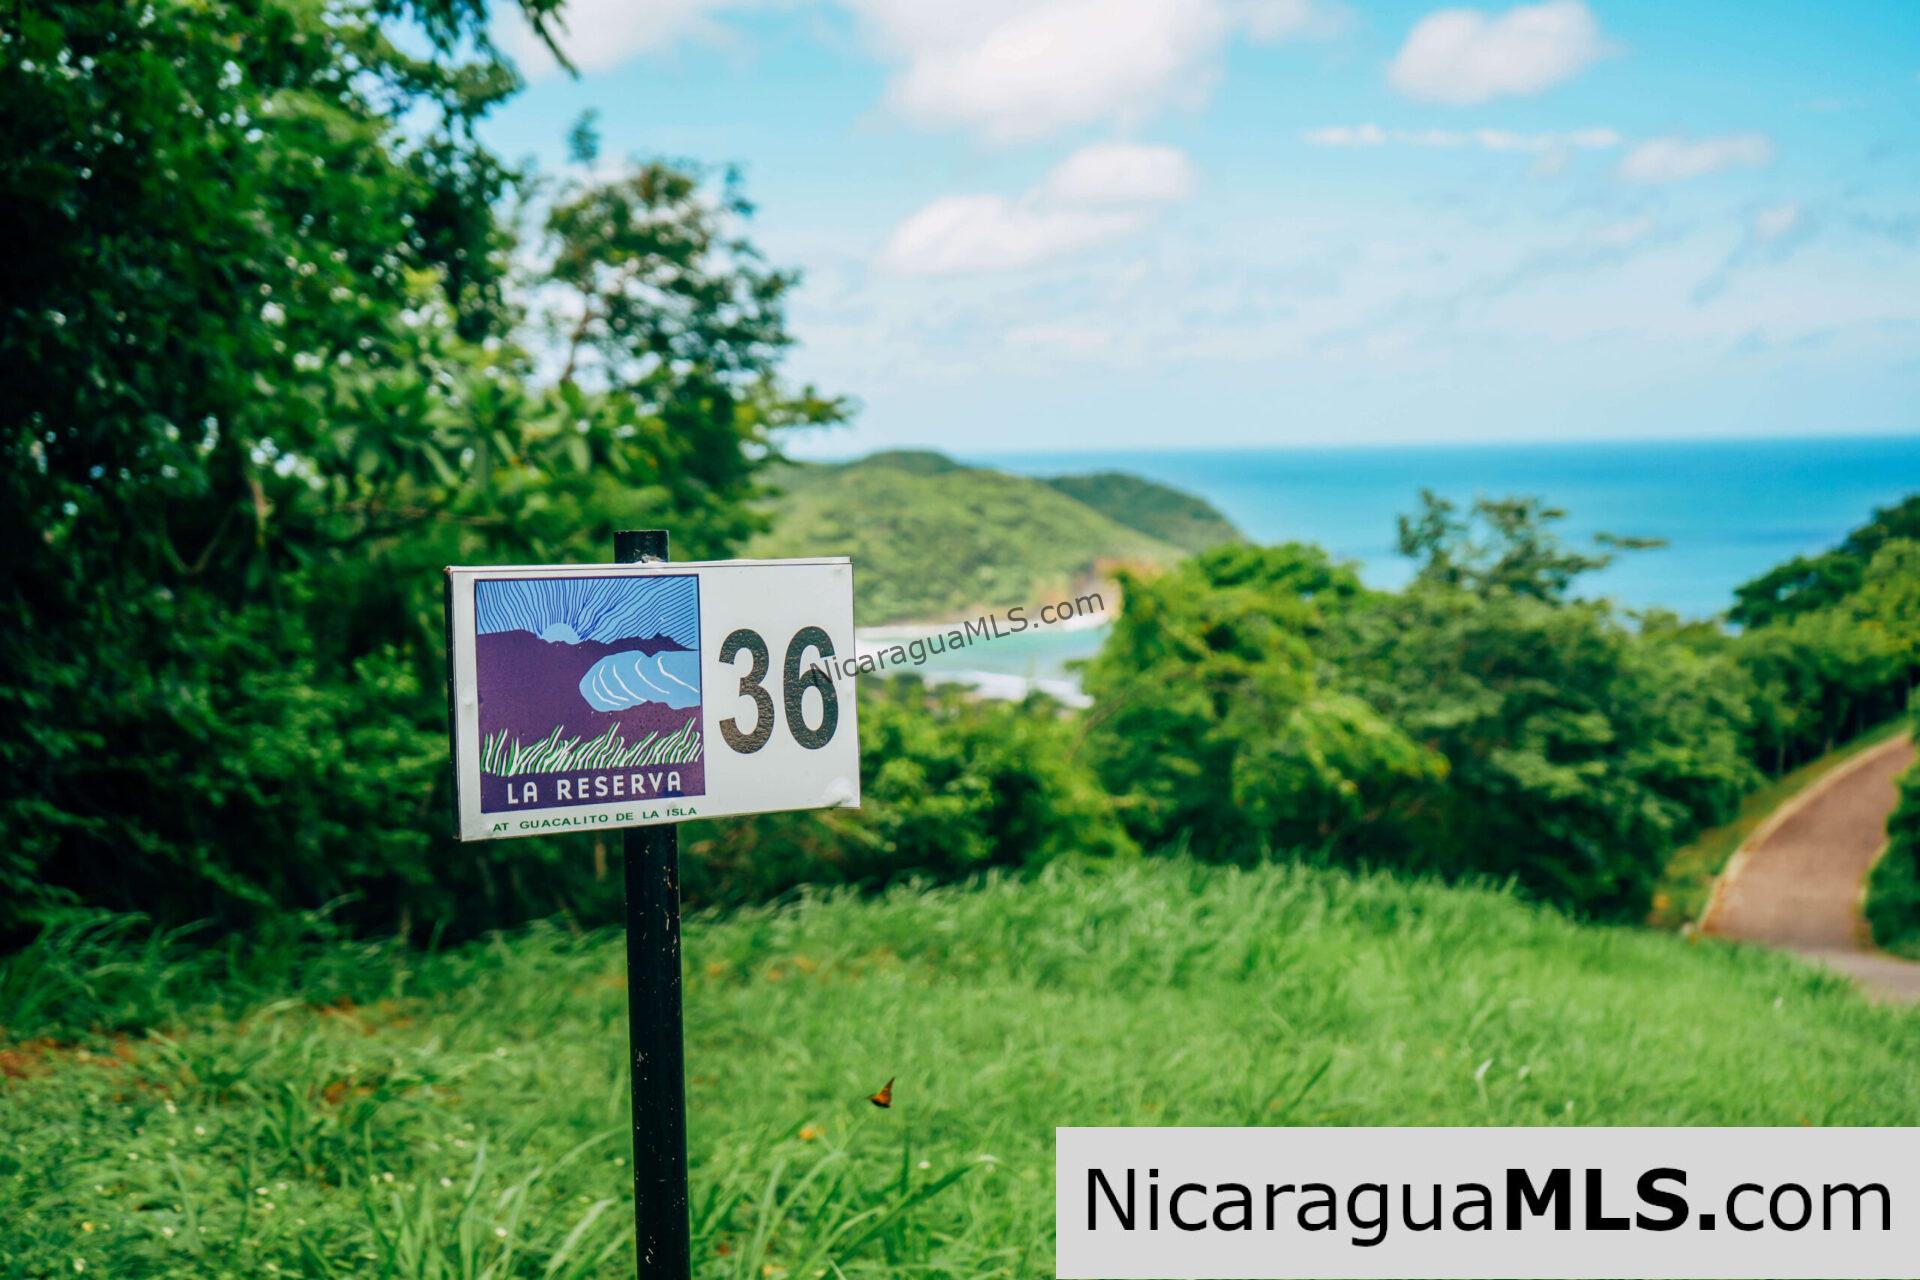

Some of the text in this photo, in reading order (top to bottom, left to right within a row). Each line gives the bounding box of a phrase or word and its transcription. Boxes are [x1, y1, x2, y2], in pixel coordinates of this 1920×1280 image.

[718, 625, 840, 755] 36
[507, 771, 681, 805] LA RESERVA
[492, 806, 698, 833] AT GUACALITO DE LA ISLA
